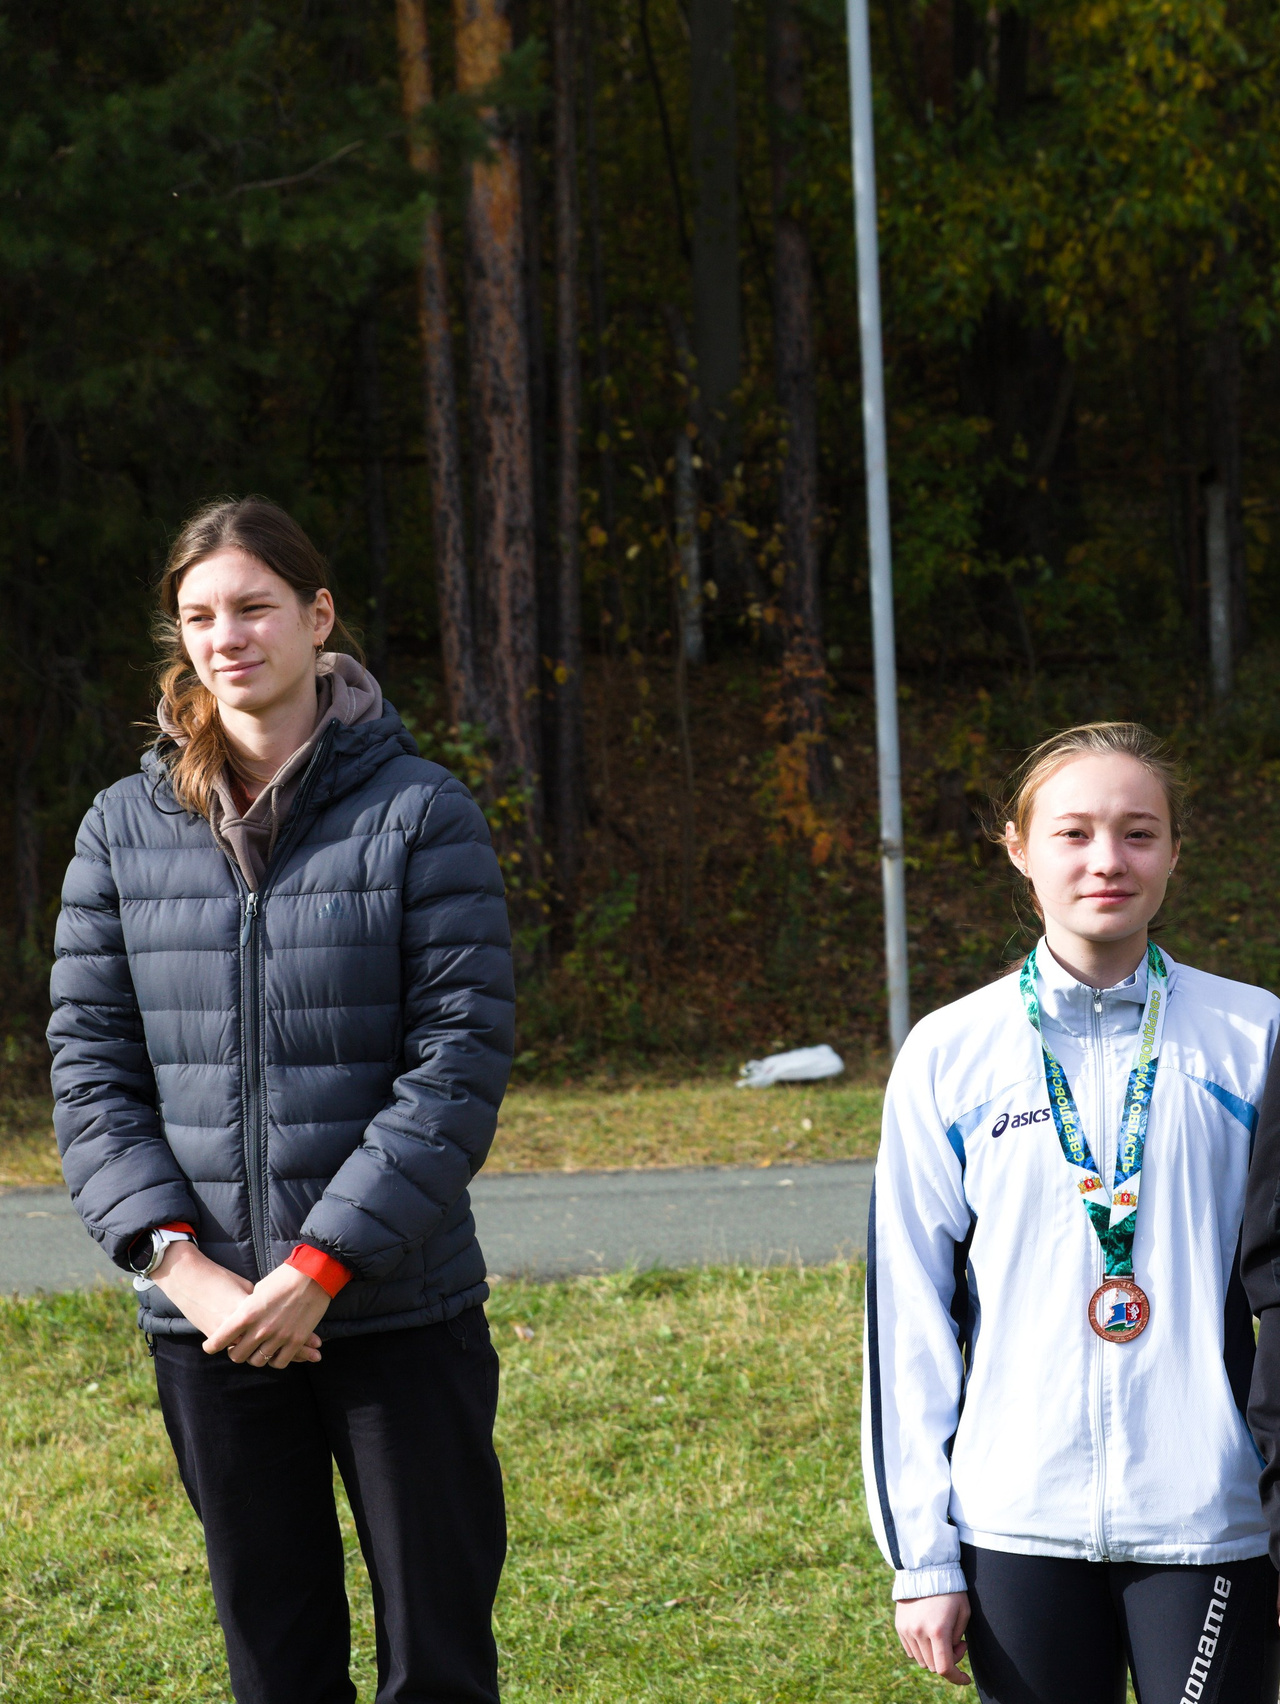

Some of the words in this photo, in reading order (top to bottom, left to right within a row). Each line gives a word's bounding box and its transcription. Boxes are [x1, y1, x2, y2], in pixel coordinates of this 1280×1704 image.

[1132, 990, 1161, 1100] СВЕРДЛОВСКАЯ
[1011, 1108, 1051, 1129] asics
[1122, 1104, 1142, 1172] ОБЛАСТЬ
[1180, 1575, 1231, 1704] oname
